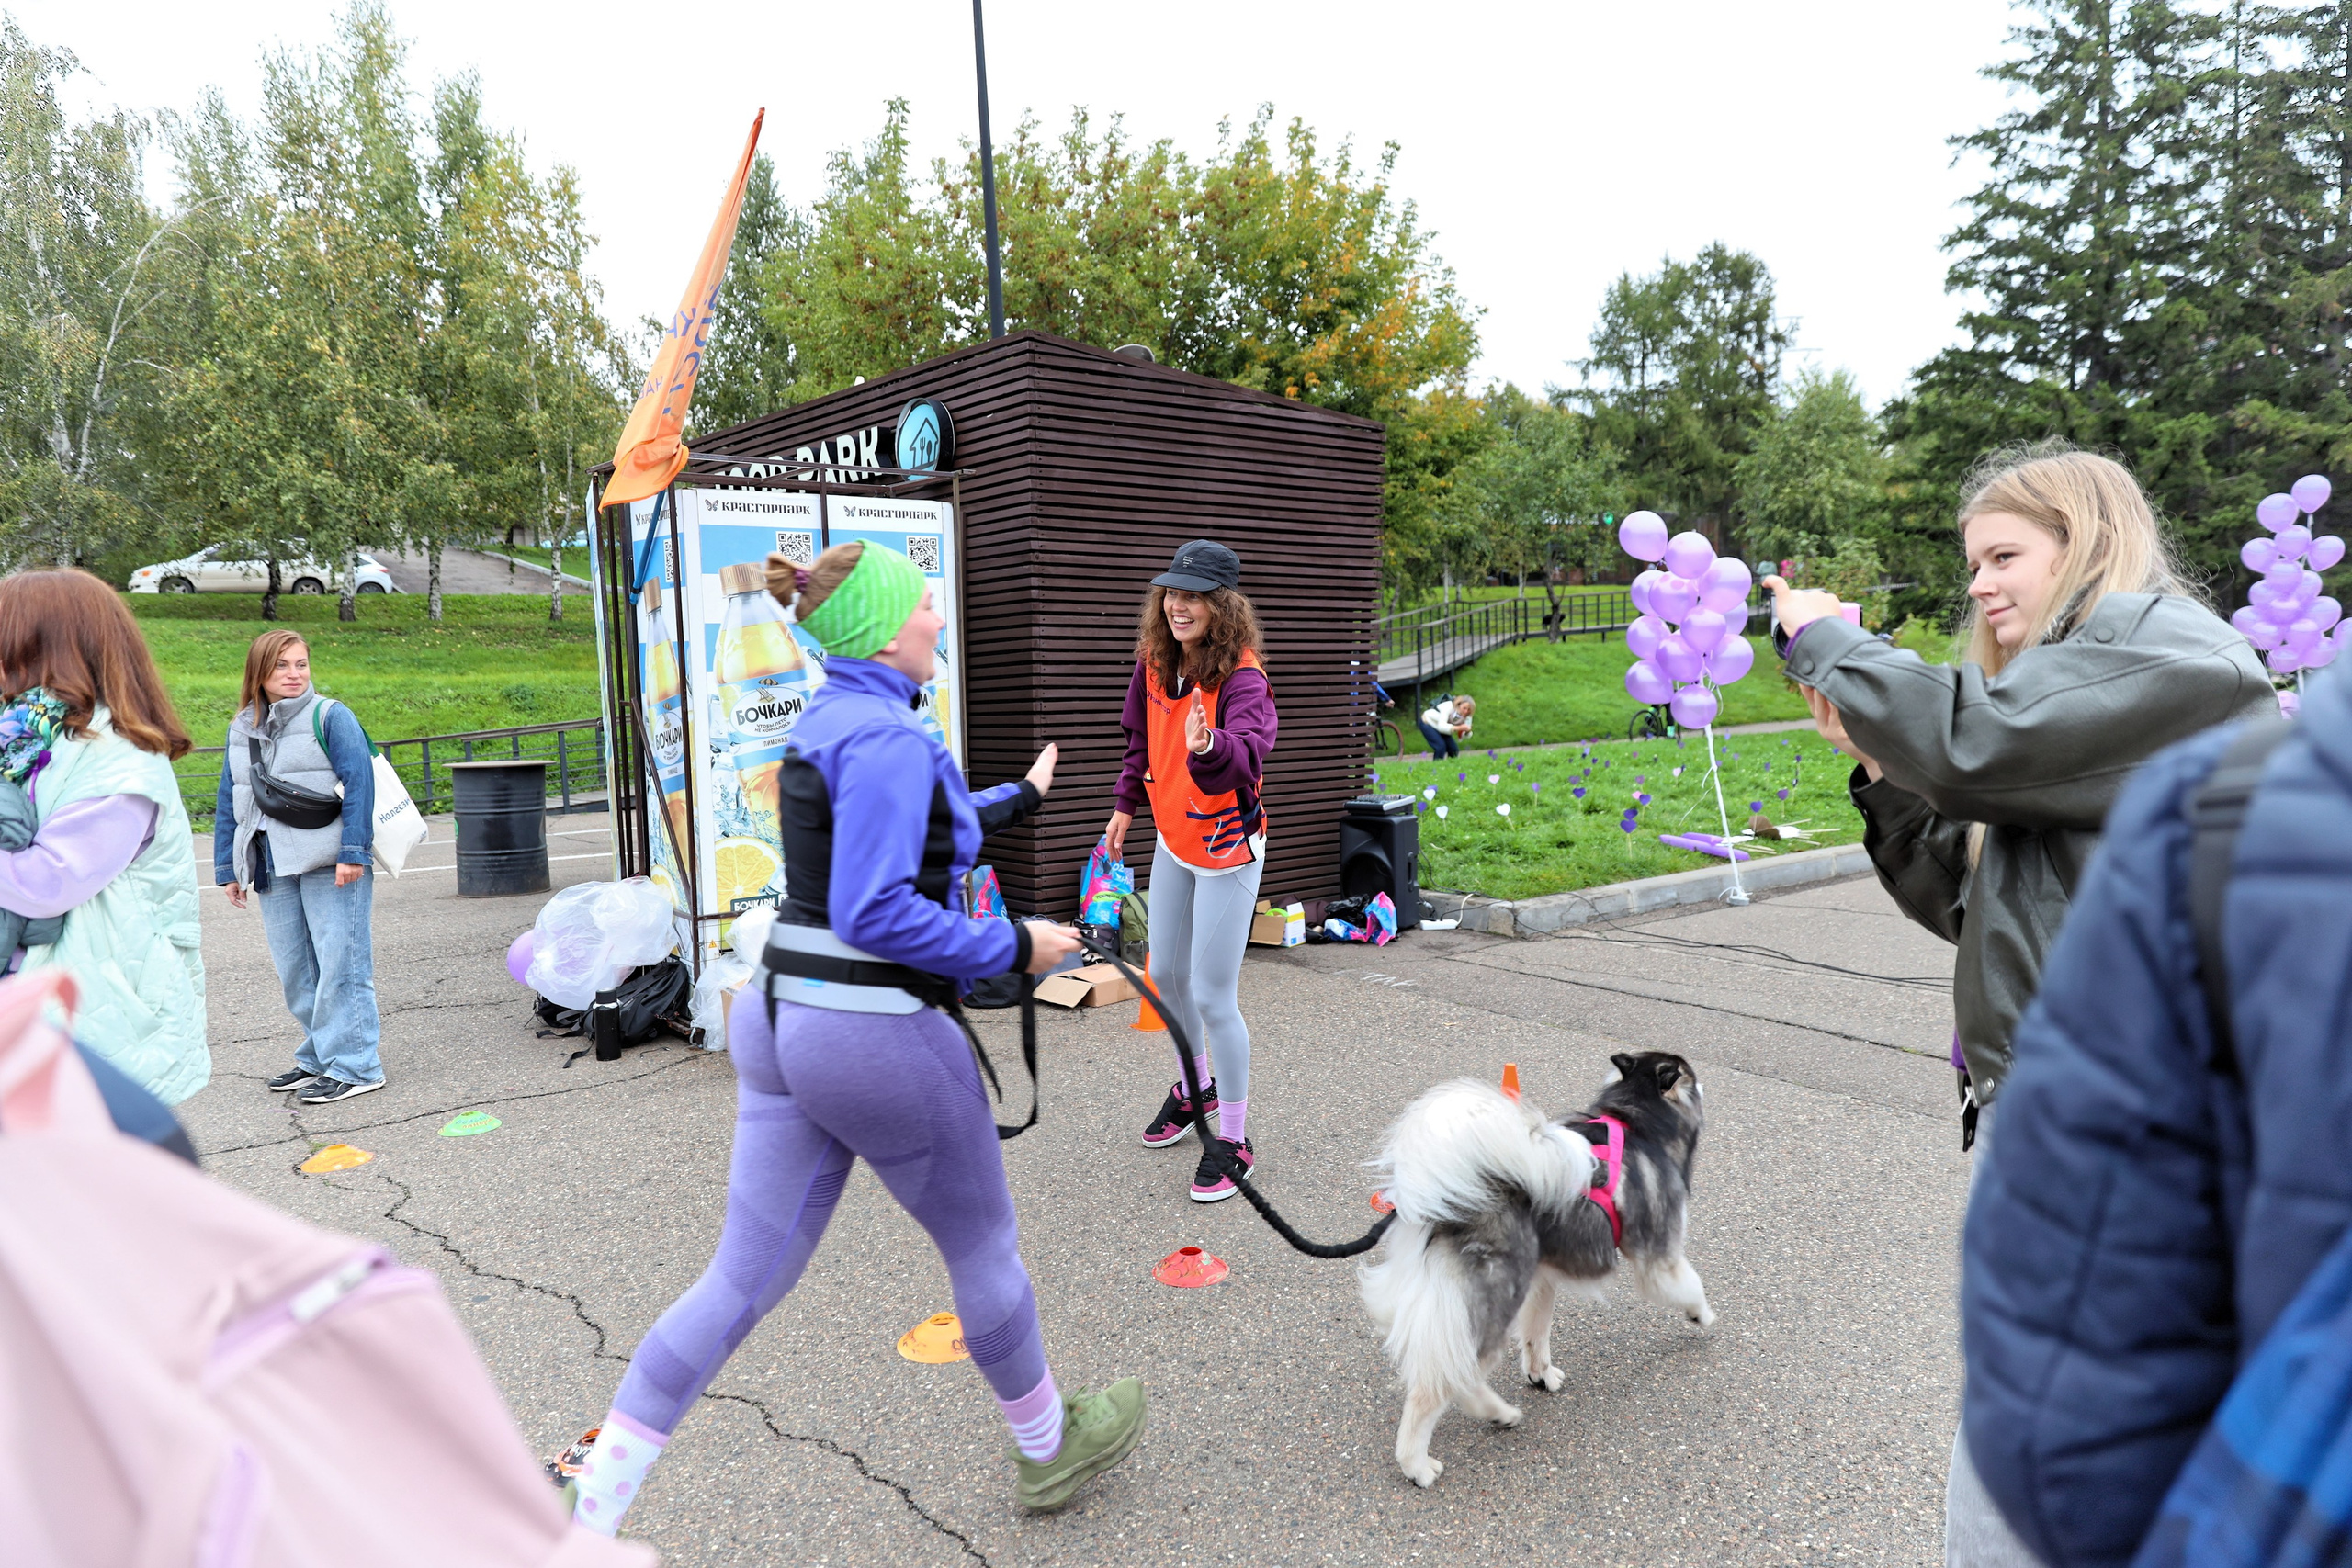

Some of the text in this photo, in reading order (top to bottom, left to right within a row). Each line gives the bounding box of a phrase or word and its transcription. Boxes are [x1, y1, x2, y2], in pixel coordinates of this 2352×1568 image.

[797, 426, 882, 493] PARK
[736, 698, 802, 726] БОЧКАРИ
[763, 737, 788, 747] ЛИМОНАД
